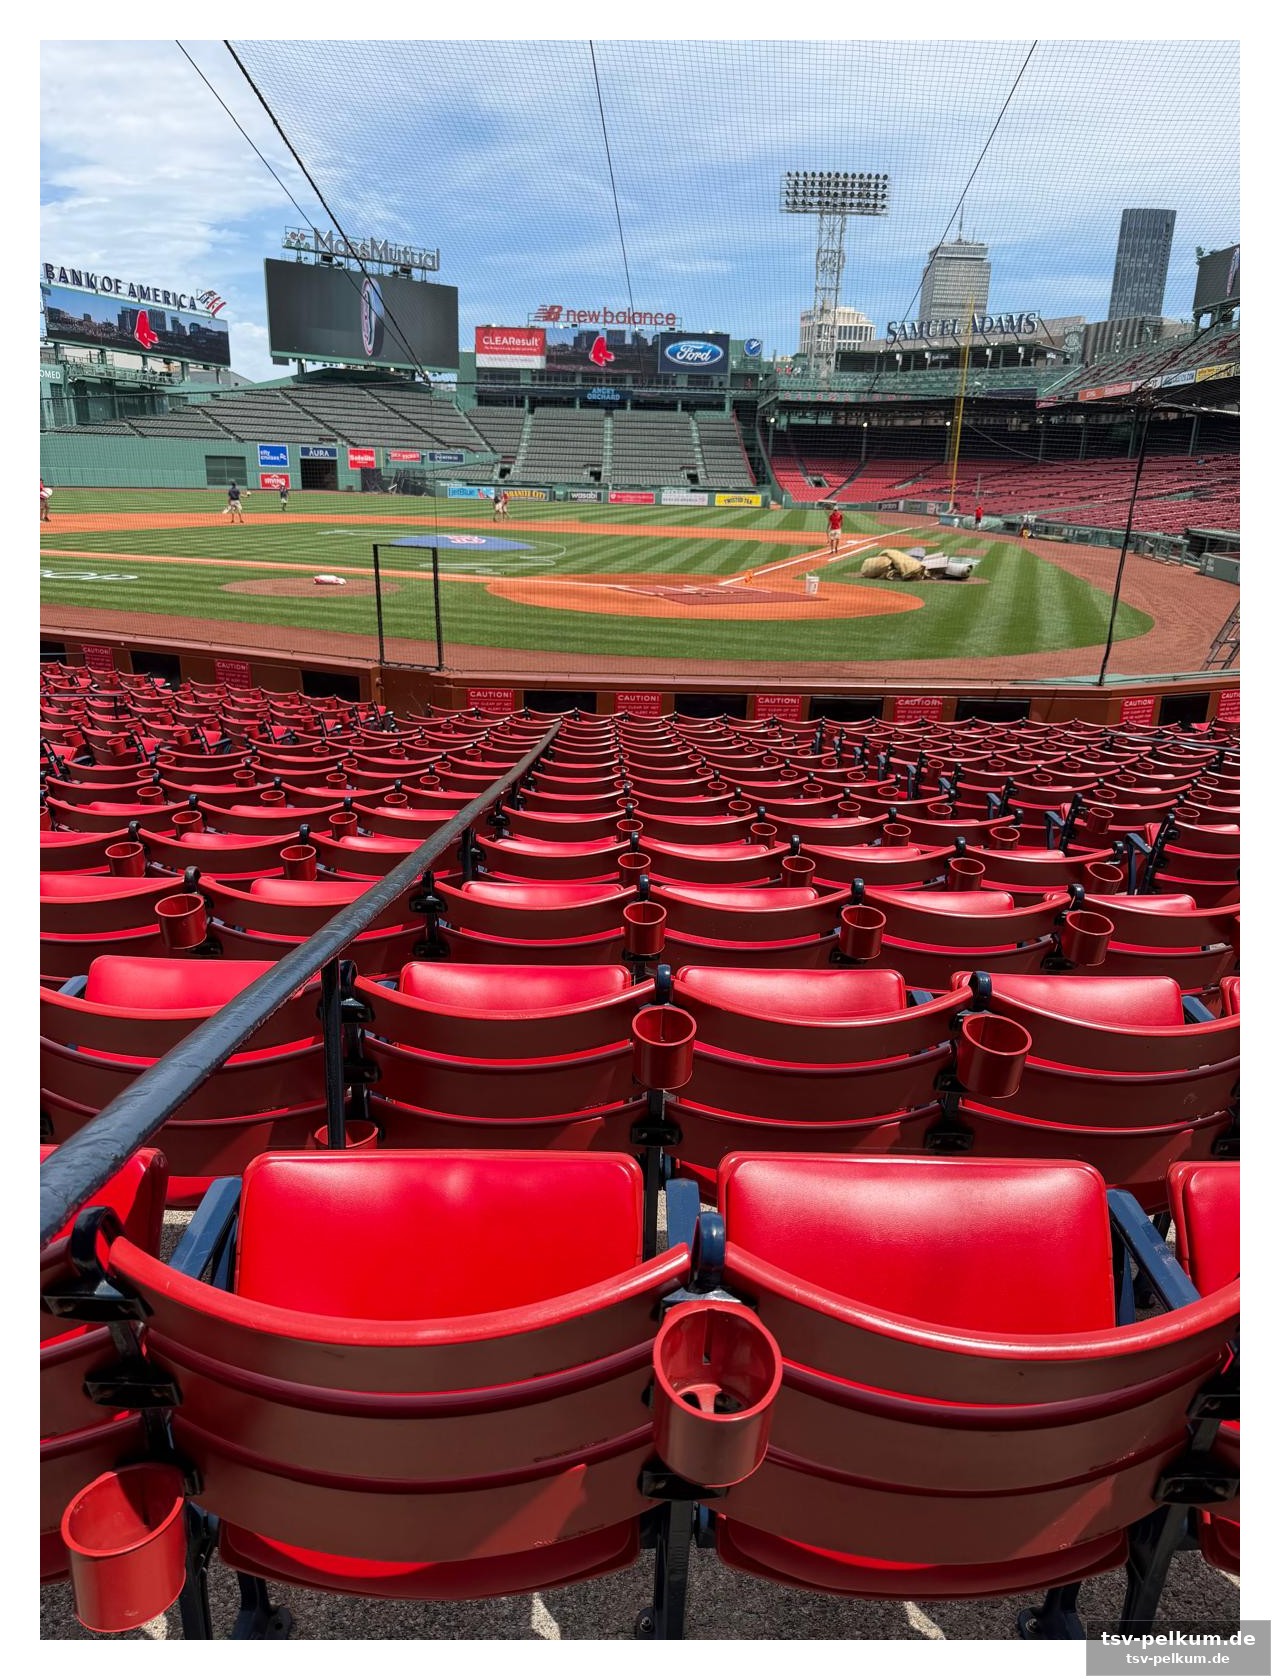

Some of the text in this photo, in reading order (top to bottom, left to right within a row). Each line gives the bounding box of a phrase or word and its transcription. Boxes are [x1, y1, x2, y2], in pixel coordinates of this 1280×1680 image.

[313, 228, 440, 271] MassMutual
[43, 263, 198, 311] BANK OF AMERICA
[566, 309, 600, 325] new
[603, 306, 677, 327] balance
[885, 312, 1037, 345] SAMUEL ADAMS
[676, 344, 713, 362] Ford
[571, 491, 597, 500] wasabi
[617, 694, 660, 702] CAUTION!
[1124, 699, 1154, 707] CAUTION!
